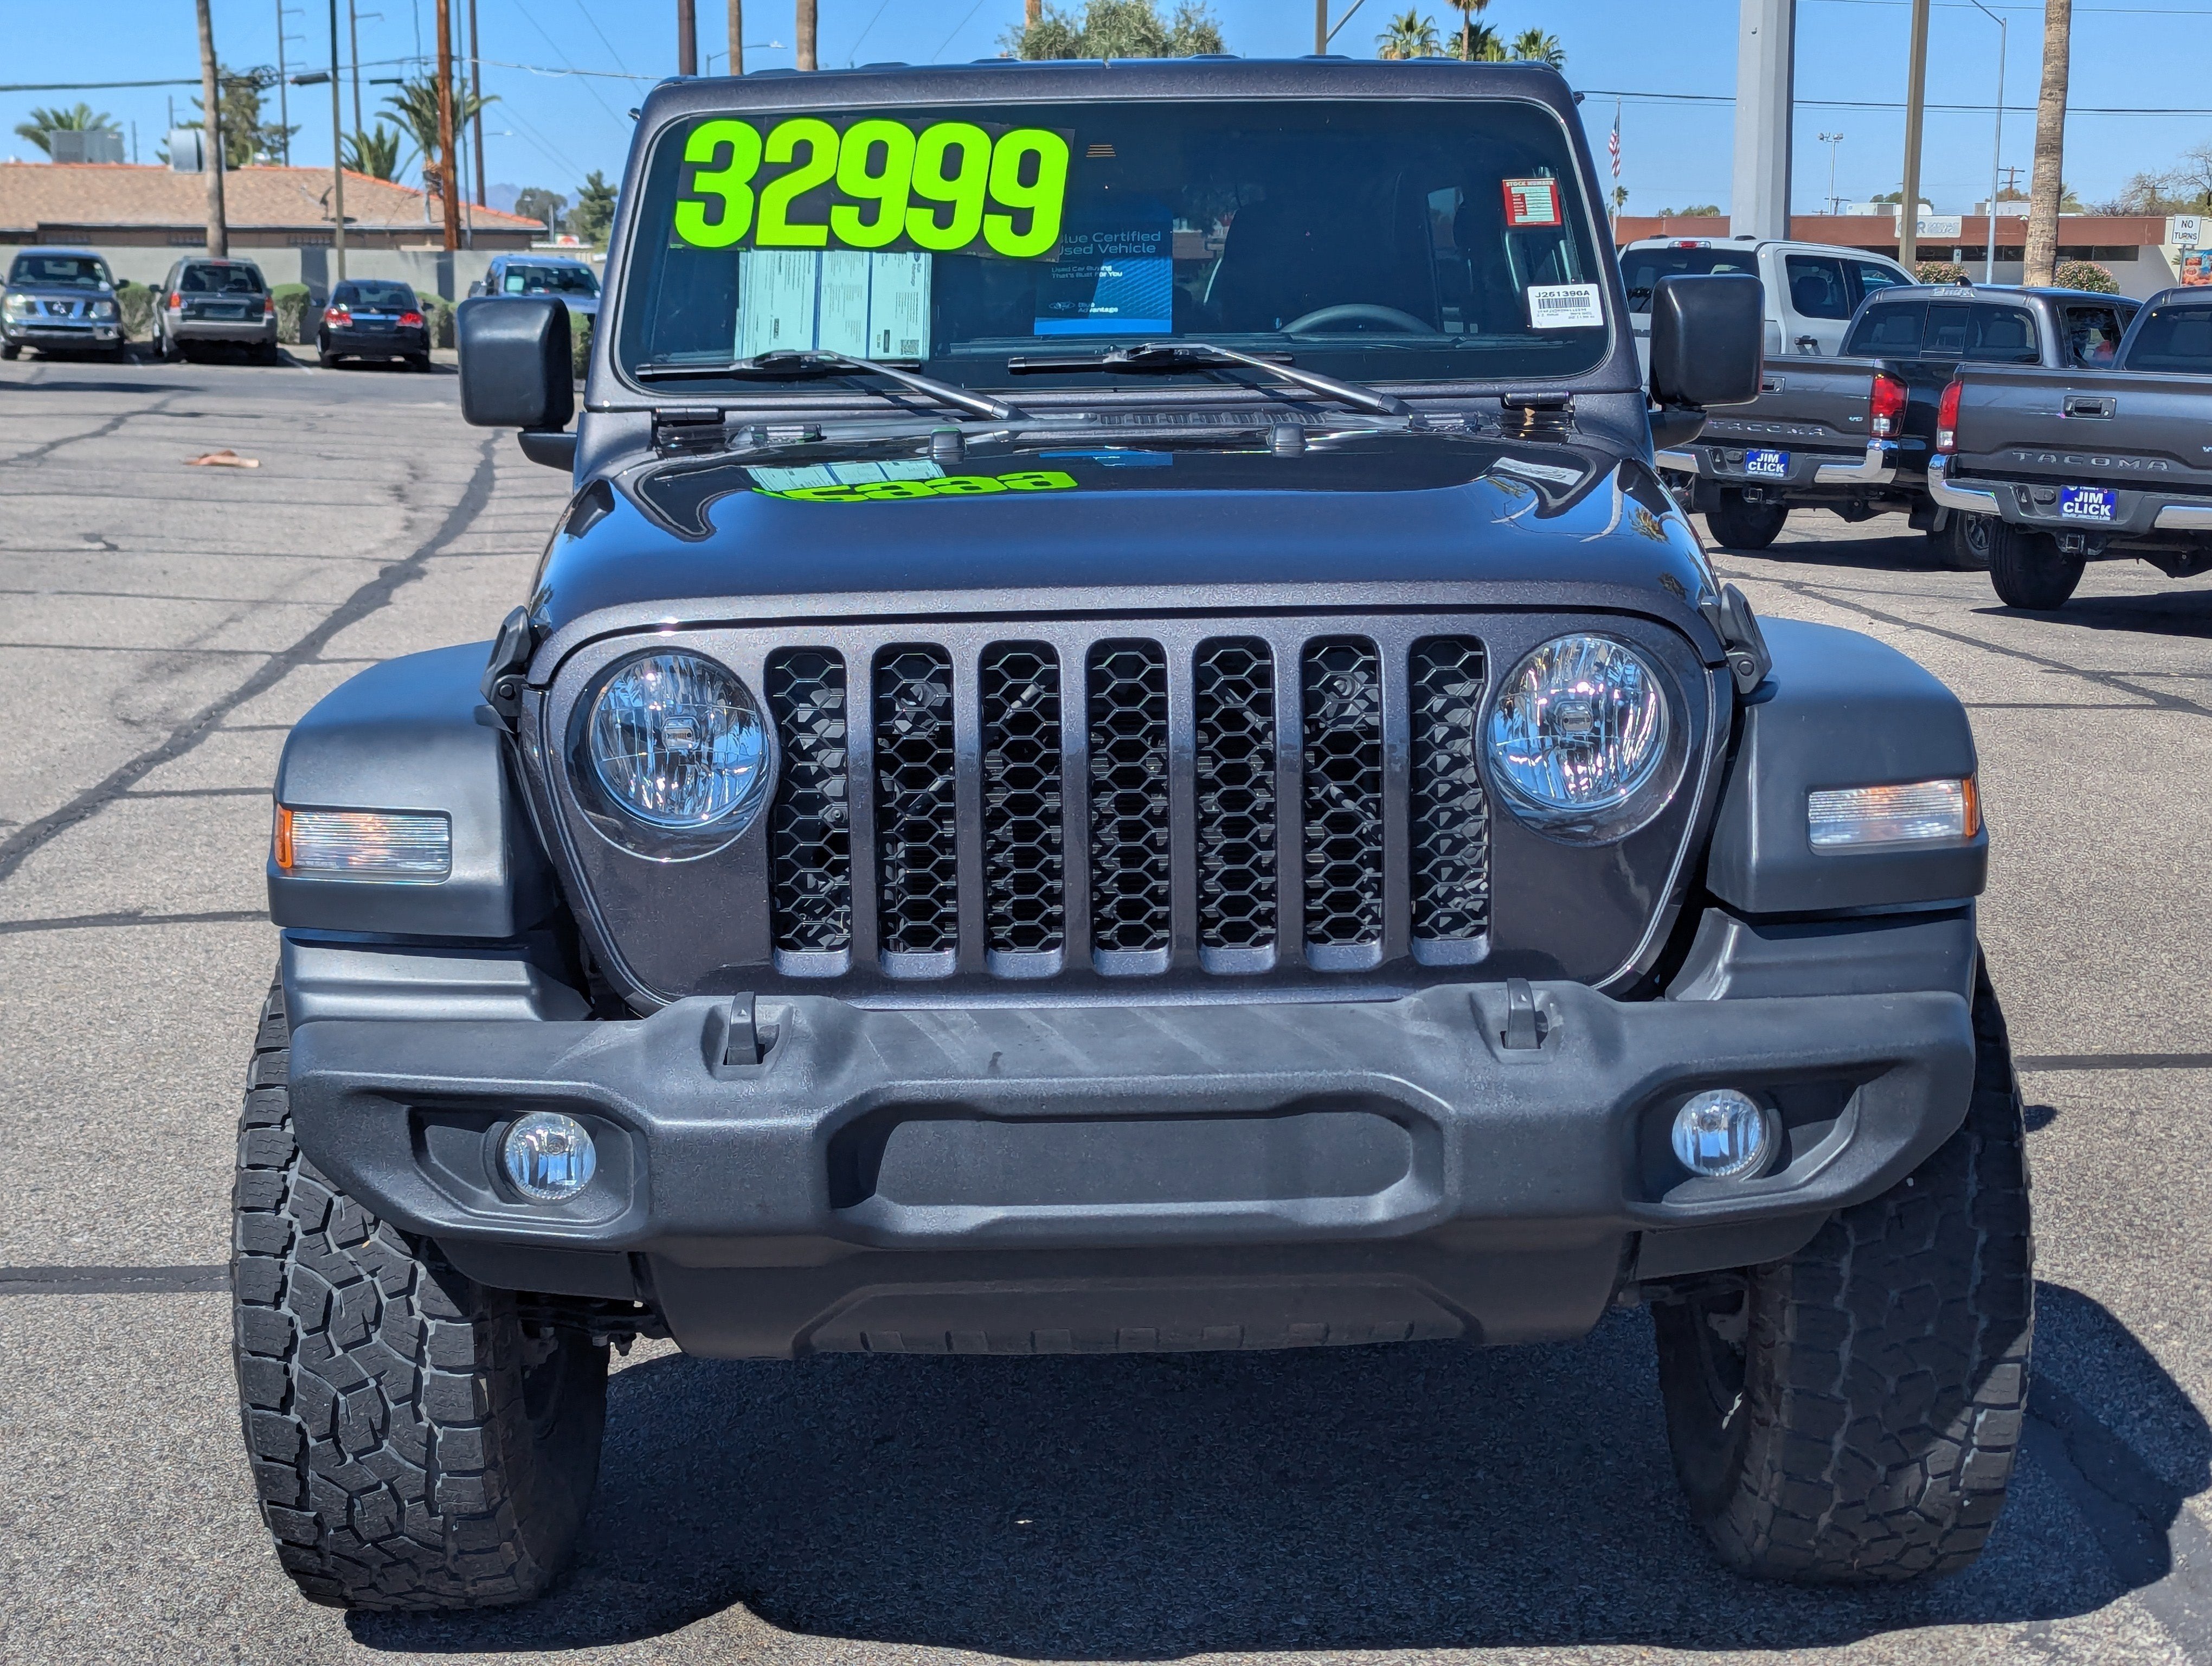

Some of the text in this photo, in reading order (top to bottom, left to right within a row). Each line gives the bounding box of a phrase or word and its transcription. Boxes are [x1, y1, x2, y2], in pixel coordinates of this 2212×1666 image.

[675, 118, 1069, 257] 32999
[2181, 220, 2194, 228] NO
[1092, 231, 1161, 242] Certified
[2174, 232, 2197, 240] TURNS
[1098, 243, 1156, 254] Vehicle
[1708, 420, 1825, 436] TACOMA
[1756, 453, 1779, 463] JIM
[2012, 450, 2169, 471] TACOMA
[1748, 462, 1785, 473] CLICK
[2074, 491, 2104, 504] JIM
[2063, 502, 2111, 516] CLICK
